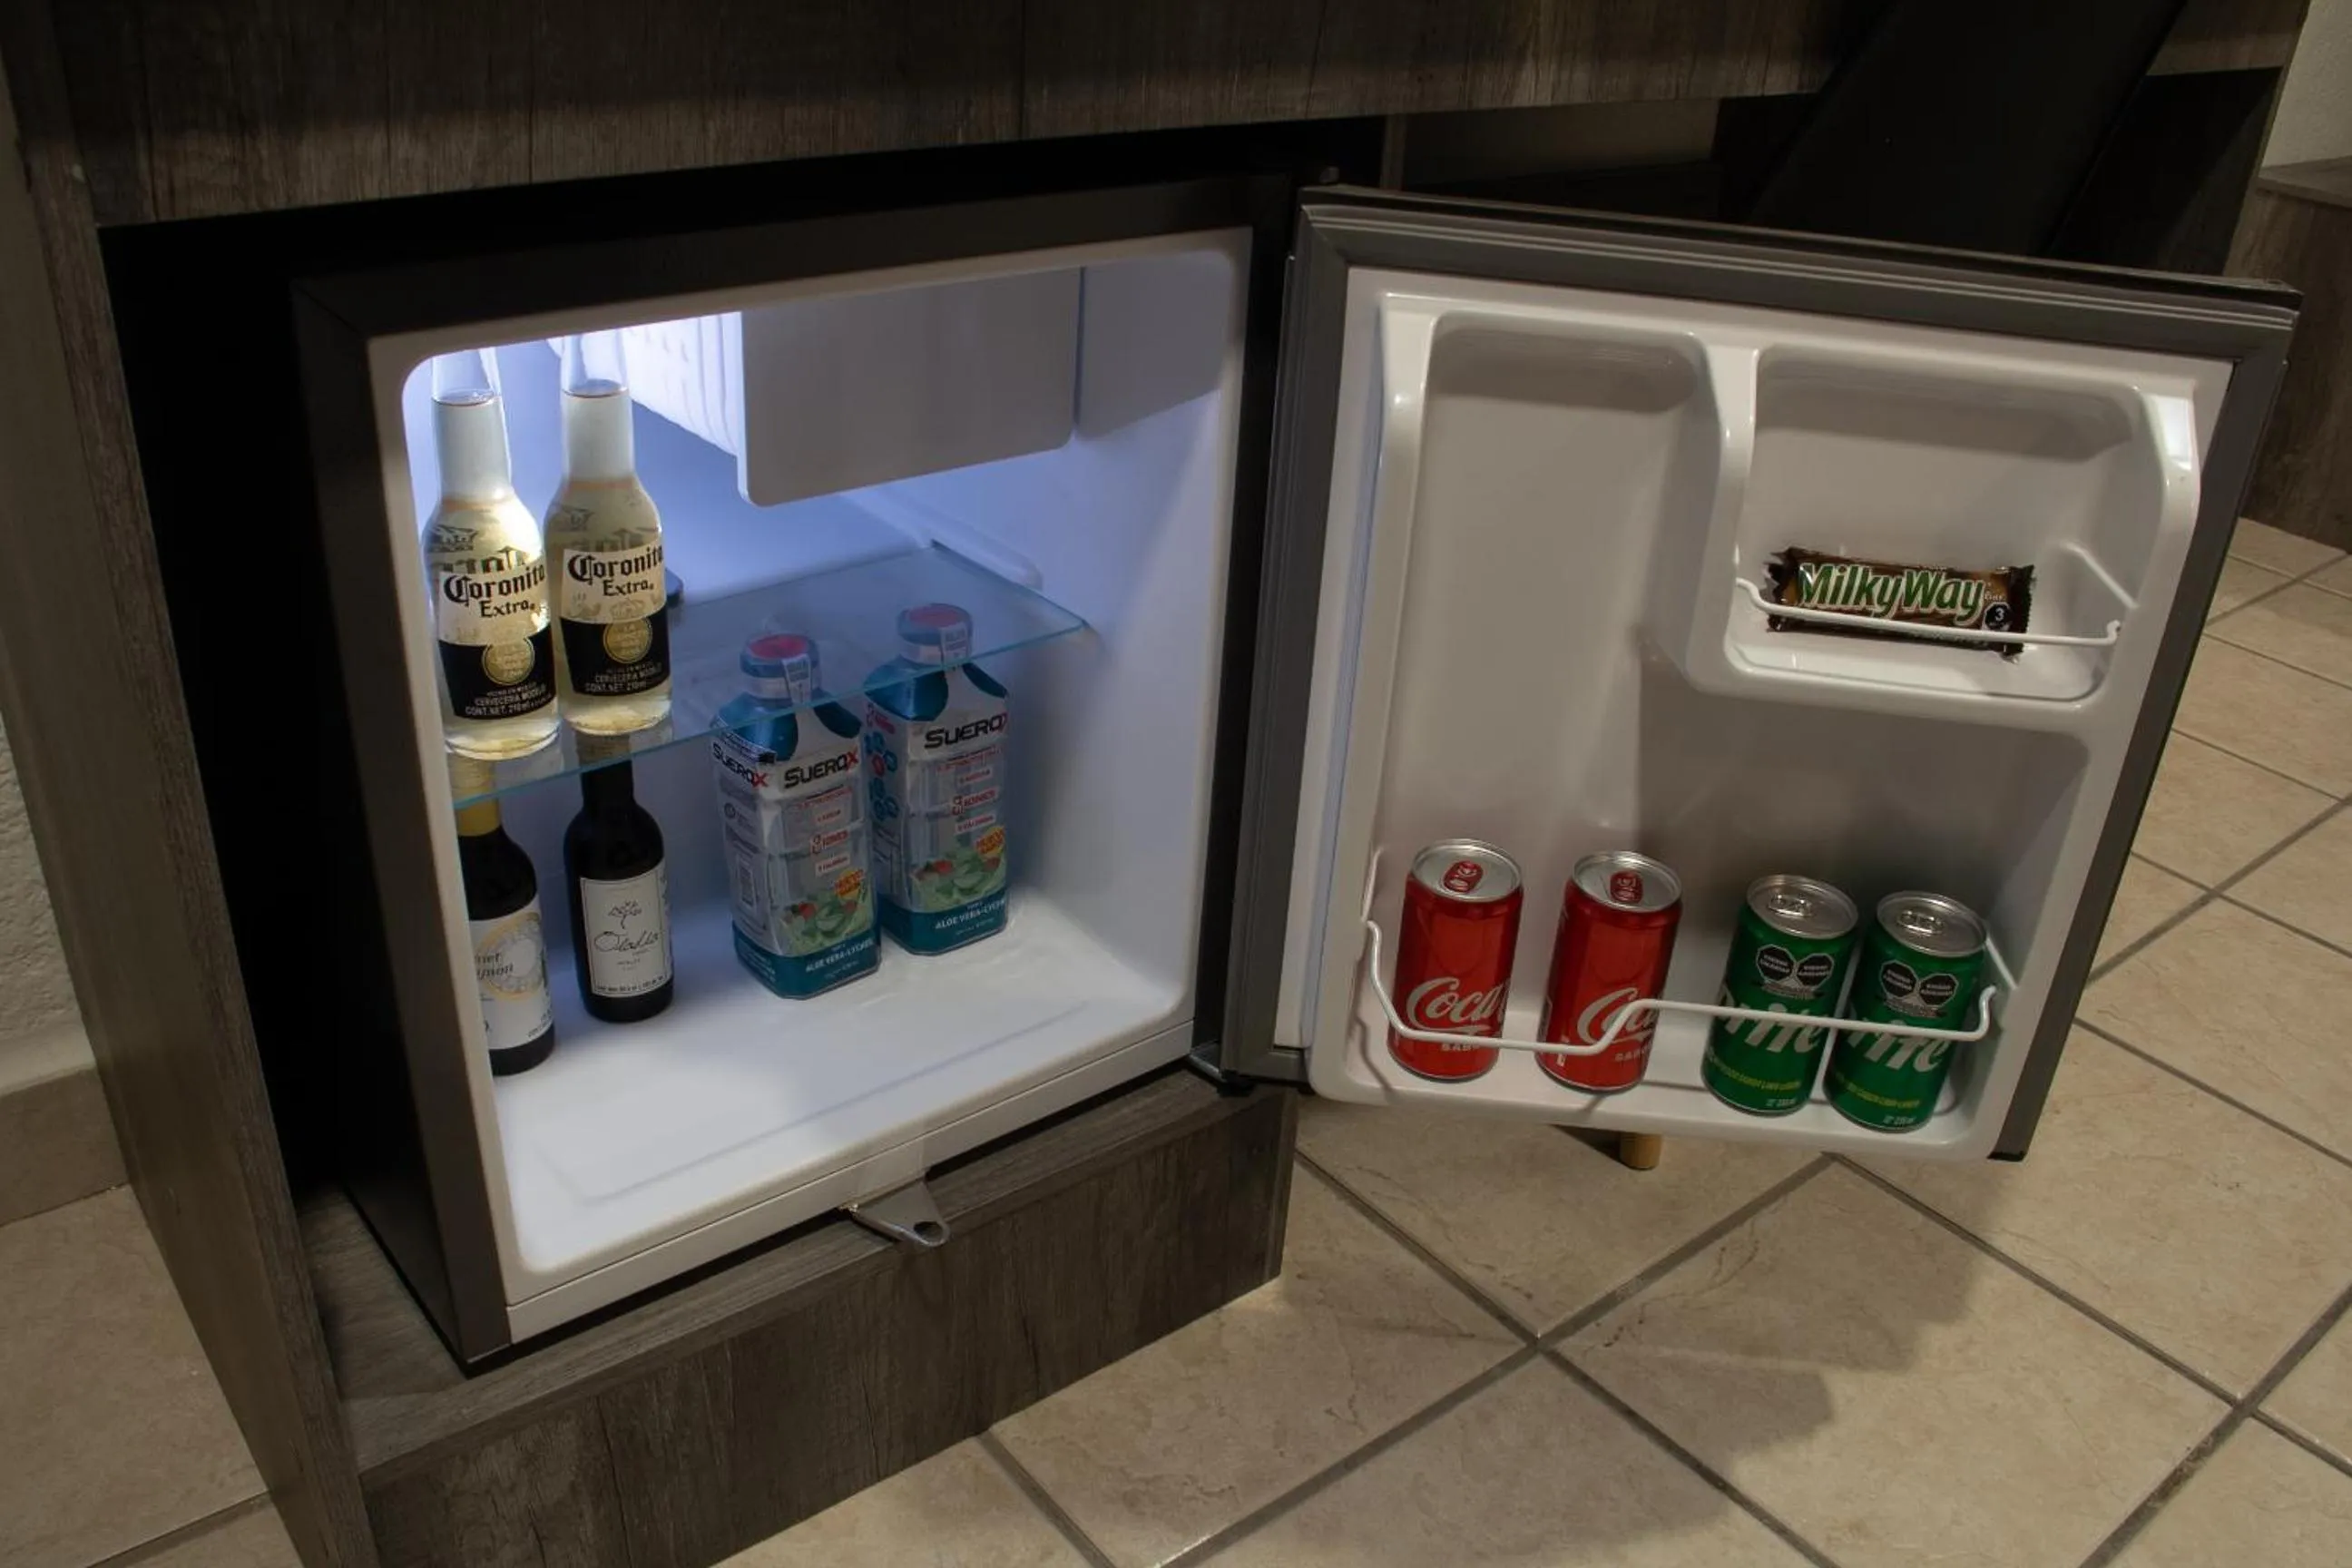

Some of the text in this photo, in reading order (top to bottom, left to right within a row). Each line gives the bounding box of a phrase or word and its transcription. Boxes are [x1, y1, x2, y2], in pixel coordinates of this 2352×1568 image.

[603, 579, 649, 597] Extra
[1798, 563, 1985, 626] Milky Way
[480, 600, 529, 618] Extra
[1995, 607, 2005, 622] 3
[712, 742, 769, 788] SUEROX
[784, 744, 859, 789] SUEROX
